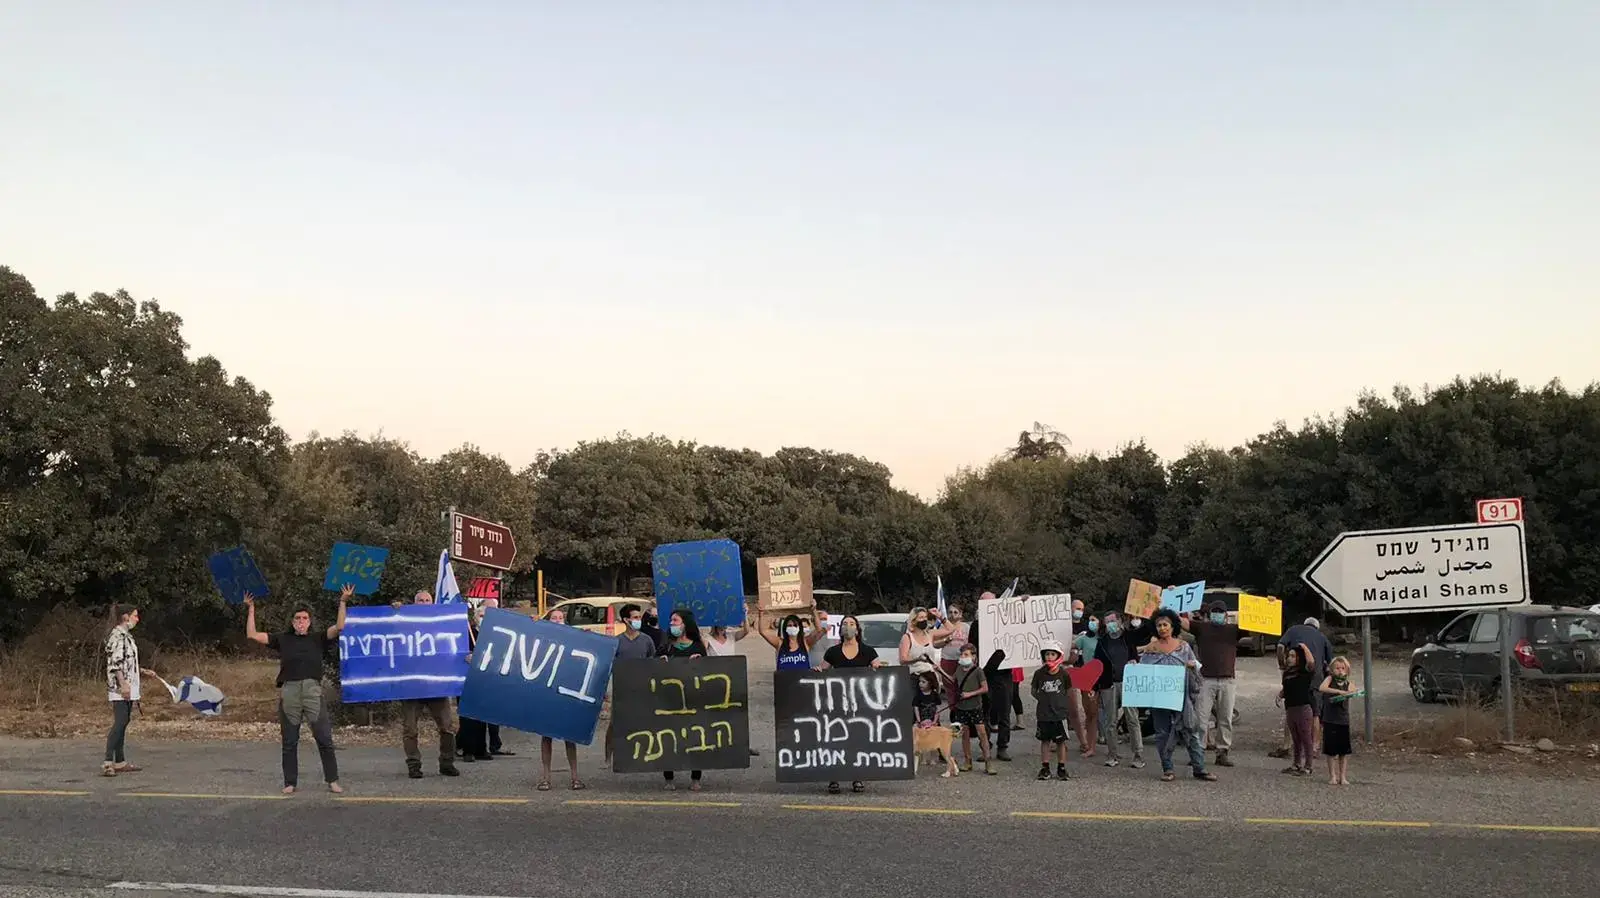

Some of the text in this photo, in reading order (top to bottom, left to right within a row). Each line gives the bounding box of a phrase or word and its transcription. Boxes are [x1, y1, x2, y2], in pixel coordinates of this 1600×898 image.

[1489, 504, 1508, 518] 91
[480, 545, 493, 558] 134
[1376, 541, 1419, 557] שמס
[1375, 558, 1492, 581] مجدل شمس
[1363, 583, 1509, 603] Majdal Shams
[988, 599, 1026, 634] חושך
[338, 631, 462, 668] דמוקרטיה
[779, 654, 806, 665] simple
[480, 625, 597, 704] בושה
[650, 673, 742, 716] ביבי
[799, 675, 896, 713] שוחד
[626, 720, 733, 762] הביתה
[794, 715, 902, 743] מרמה
[778, 747, 908, 768] הפרת אמונים
